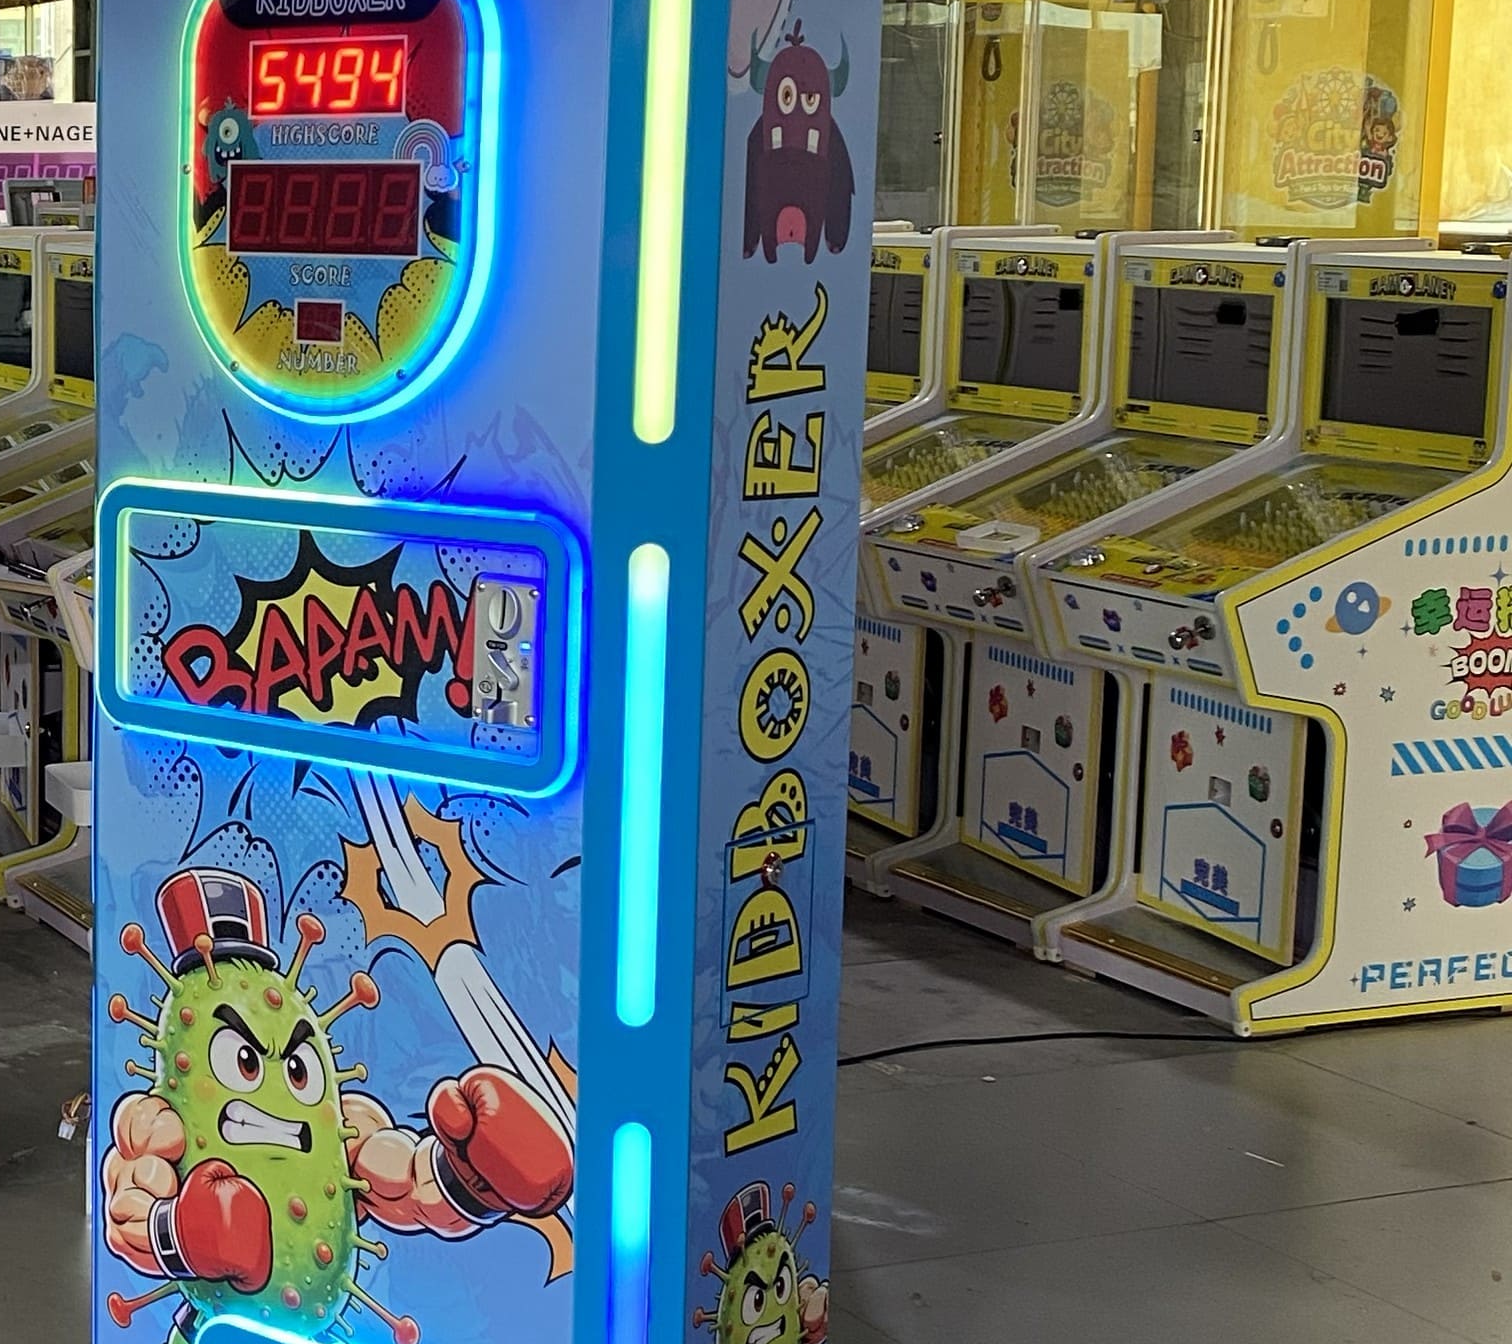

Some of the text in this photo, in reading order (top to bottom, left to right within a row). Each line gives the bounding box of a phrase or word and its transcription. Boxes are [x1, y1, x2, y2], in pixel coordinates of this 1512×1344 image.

[254, 47, 404, 112] 5494
[271, 122, 381, 146] HIGHSCORE
[1277, 148, 1386, 184] Attraction
[289, 263, 353, 287] SCORE
[276, 348, 360, 376] NUMBER
[722, 280, 830, 1158] KIDBOXER
[1431, 696, 1488, 721] GOOD
